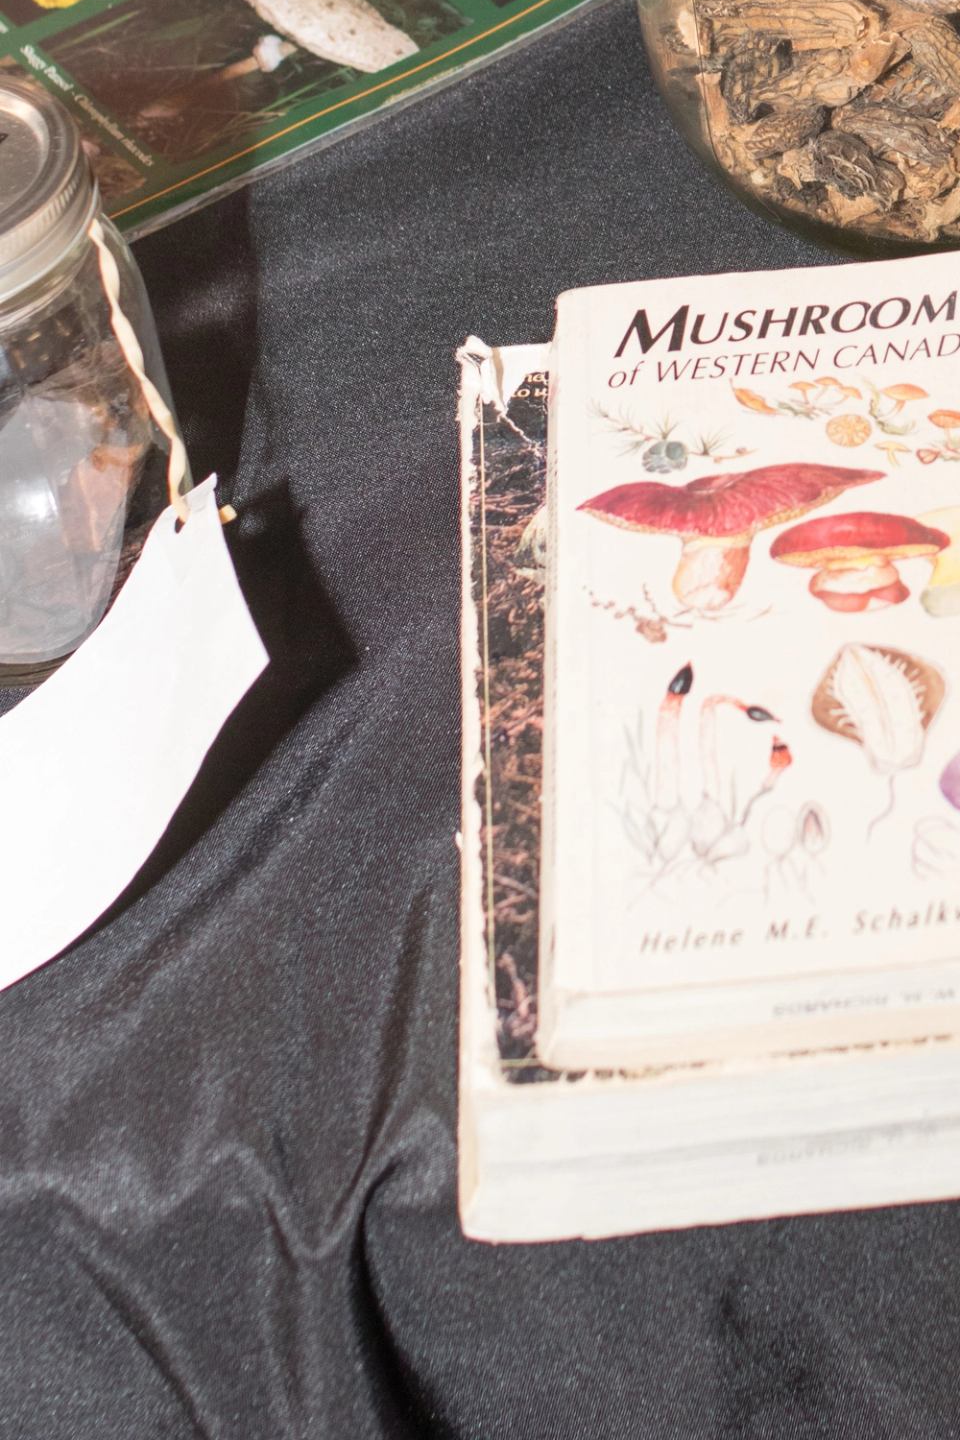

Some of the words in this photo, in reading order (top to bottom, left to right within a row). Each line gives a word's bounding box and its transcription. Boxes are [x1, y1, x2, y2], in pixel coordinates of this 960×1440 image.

[607, 360, 642, 389] of
[656, 349, 820, 382] WESTERN
[639, 926, 743, 953] Helene
[765, 916, 831, 941] M.E.
